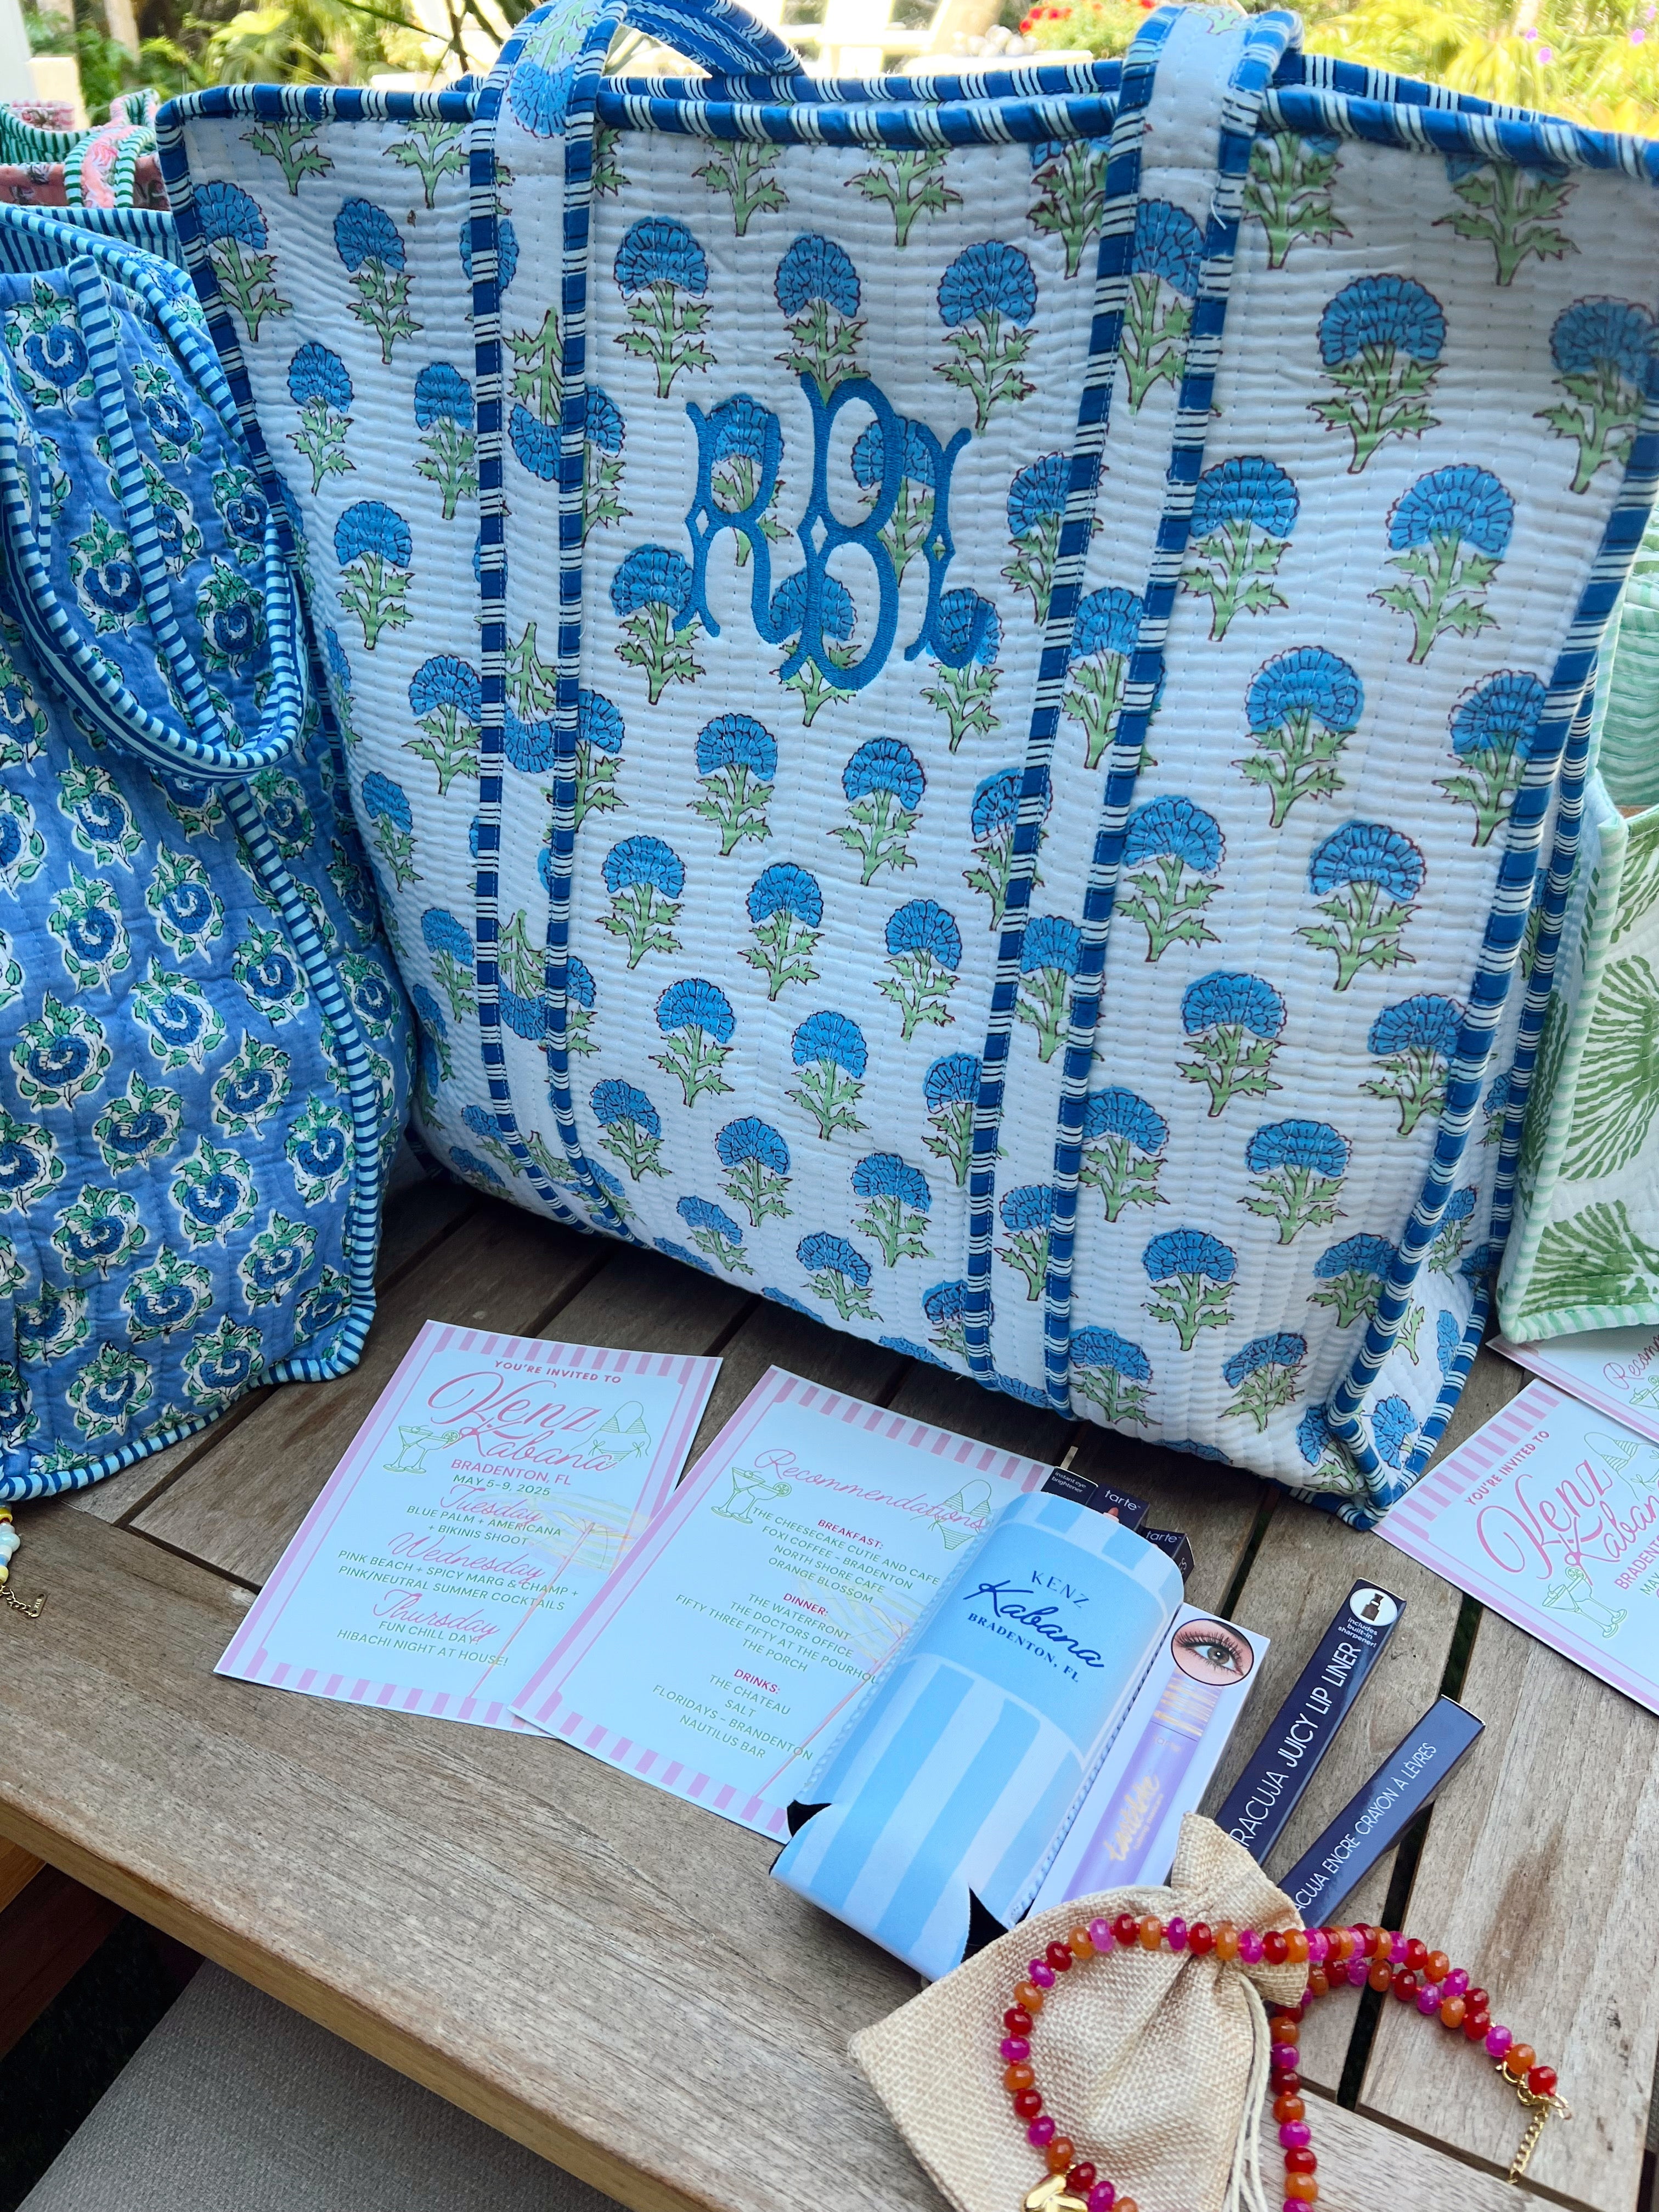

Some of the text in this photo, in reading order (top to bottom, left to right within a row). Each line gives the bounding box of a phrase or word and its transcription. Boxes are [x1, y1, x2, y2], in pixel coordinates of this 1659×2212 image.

[494, 1360, 621, 1383] YOU'RE INVITED TO
[427, 1372, 602, 1440] Kenz
[442, 1417, 619, 1471] Kabana
[451, 1459, 571, 1485] BRADENTON, FL
[453, 1474, 483, 1486] MAY
[516, 1483, 550, 1496] 2025
[754, 1448, 988, 1530] Recommendations
[1051, 1476, 1083, 1492] brightener
[1055, 1471, 1075, 1483] instant
[1464, 1431, 1549, 1505] YOU'RE INVITED TO
[407, 1505, 438, 1518] BLUE
[439, 1511, 475, 1523] PALM
[488, 1519, 562, 1536] AMERICANA
[440, 1484, 544, 1526] Tuesday
[1104, 1489, 1137, 1511] tarte
[1476, 1459, 1613, 1580] Kenz
[438, 1525, 482, 1539] BIKINIS
[484, 1532, 529, 1546] SHOOT
[753, 1506, 940, 1585] THE CHEESECAKE CUTIE AND CAFE
[818, 1519, 884, 1549] BREAKFAST:
[1146, 1530, 1178, 1543] tarte
[1558, 1480, 1659, 1586] Kaban
[338, 1550, 366, 1563] PINK
[370, 1556, 413, 1572] BEACH
[426, 1566, 464, 1579] SPICY
[466, 1573, 504, 1587] MARG
[507, 1579, 517, 1589] &
[521, 1581, 568, 1595] CHAMP
[388, 1532, 546, 1587] Wednesday
[762, 1525, 788, 1542] FOXI
[790, 1537, 832, 1559] COFFEE
[843, 1557, 914, 1589] BRADENTON
[774, 1545, 884, 1593] NORTH SHORE CAFE
[1614, 1534, 1659, 1590] BRADENT
[338, 1565, 565, 1611] PINK/NEUTRAL SUMMER COCKTAILS
[768, 1557, 874, 1604] ORANGE BLOSSOM
[1031, 1570, 1090, 1609] KENZ
[373, 1589, 500, 1642] Thursday
[748, 1593, 852, 1641] THE WATERFRONT
[783, 1593, 829, 1616] DINNER:
[962, 1579, 1105, 1668] Kabana
[1347, 1617, 1378, 1635] includes
[337, 1629, 509, 1667] HIBACHI NIGHT AT HOUSE!
[379, 1621, 405, 1634] FUN
[408, 1626, 444, 1640] CHILL
[675, 1594, 707, 1613] FIFTY
[709, 1608, 744, 1628] THREE
[745, 1624, 777, 1643] FIFTY
[778, 1638, 795, 1651] AT
[797, 1645, 819, 1661] THE
[730, 1601, 854, 1658] THE DOCTORS OFFICE
[967, 1612, 1080, 1683] BRADENTON, FL
[1338, 1626, 1377, 1647] sharpener!
[1347, 1623, 1373, 1639] built-in
[742, 1638, 809, 1673] THE PORCH
[709, 1674, 791, 1716] THE CHATEAU
[733, 1668, 781, 1695] DRINKS:
[652, 1684, 717, 1719] FLORIDAYS
[728, 1719, 814, 1760] BRANDENTON
[724, 1699, 757, 1718] SALT
[679, 1714, 766, 1759] NAUTILUS BAR
[1229, 1641, 1361, 1850] RACUJA JUICY LIP LINER
[1322, 1833, 1361, 1874] ENCRE
[1355, 1787, 1399, 1835] CRAYON
[1390, 1776, 1409, 1791] À
[1400, 1742, 1437, 1780] LÈVRES
